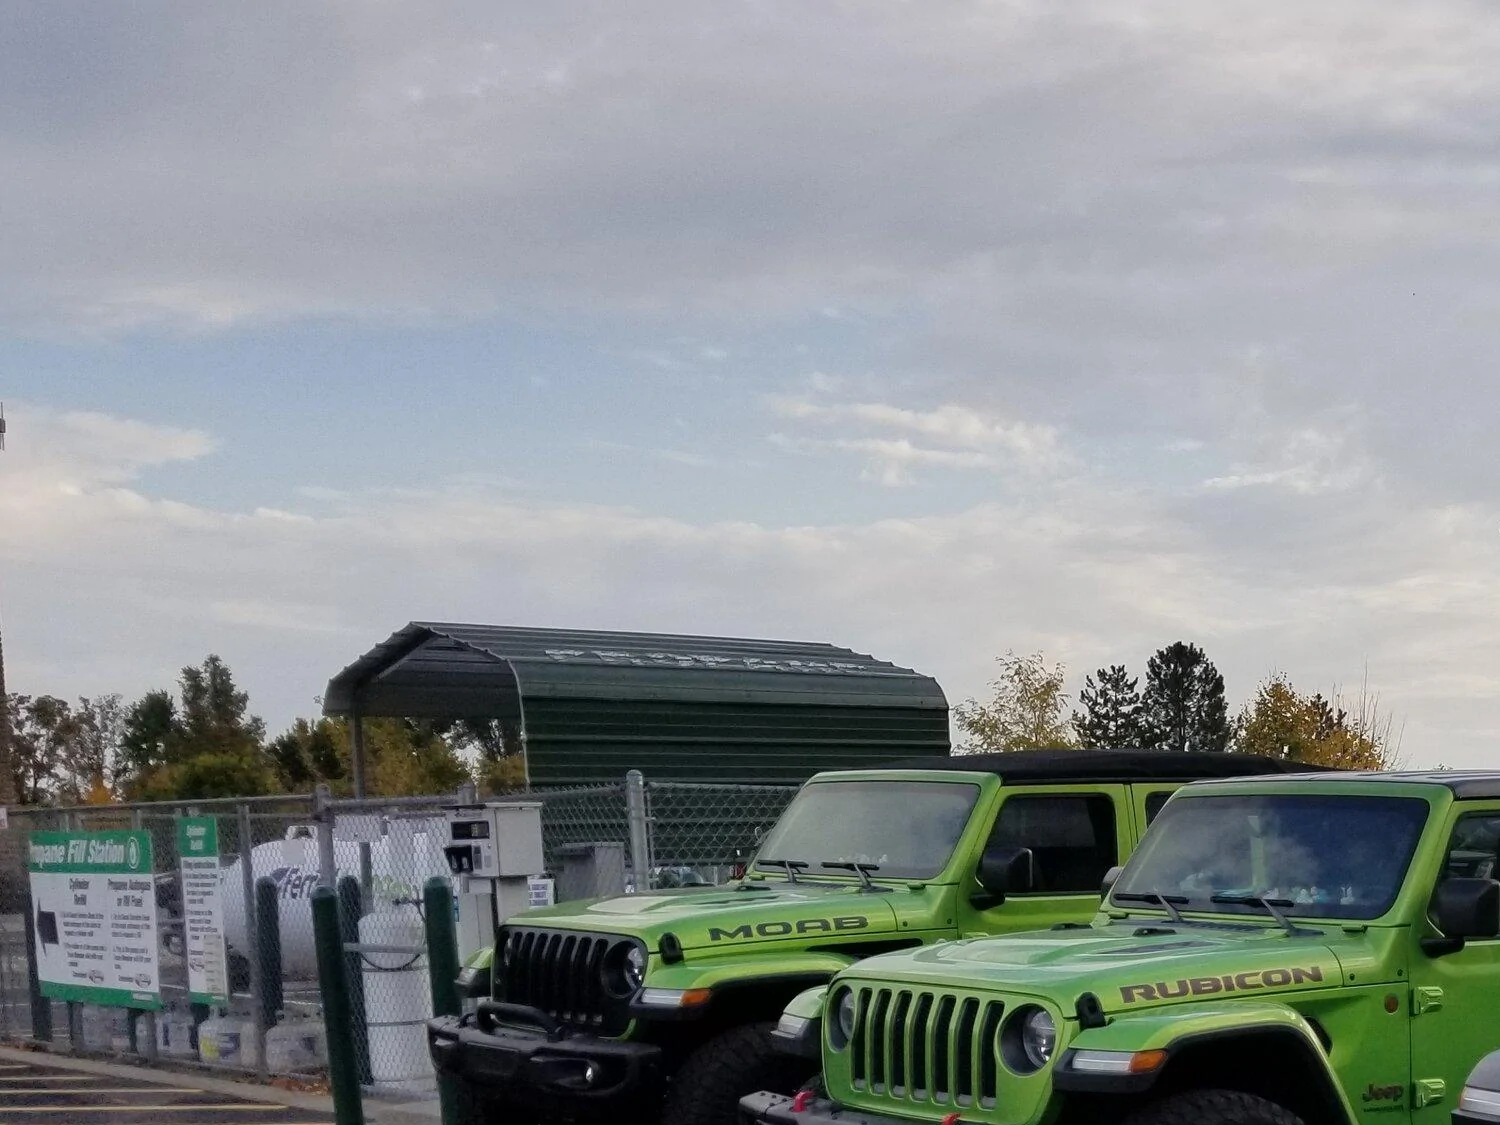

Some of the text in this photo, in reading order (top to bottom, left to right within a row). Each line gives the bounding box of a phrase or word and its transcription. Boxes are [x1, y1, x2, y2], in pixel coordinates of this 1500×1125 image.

[29, 839, 125, 869] ropane Fill Station
[708, 915, 869, 941] MOAB
[1119, 966, 1323, 1004] RUBICON
[1362, 1083, 1404, 1102] Jeep
